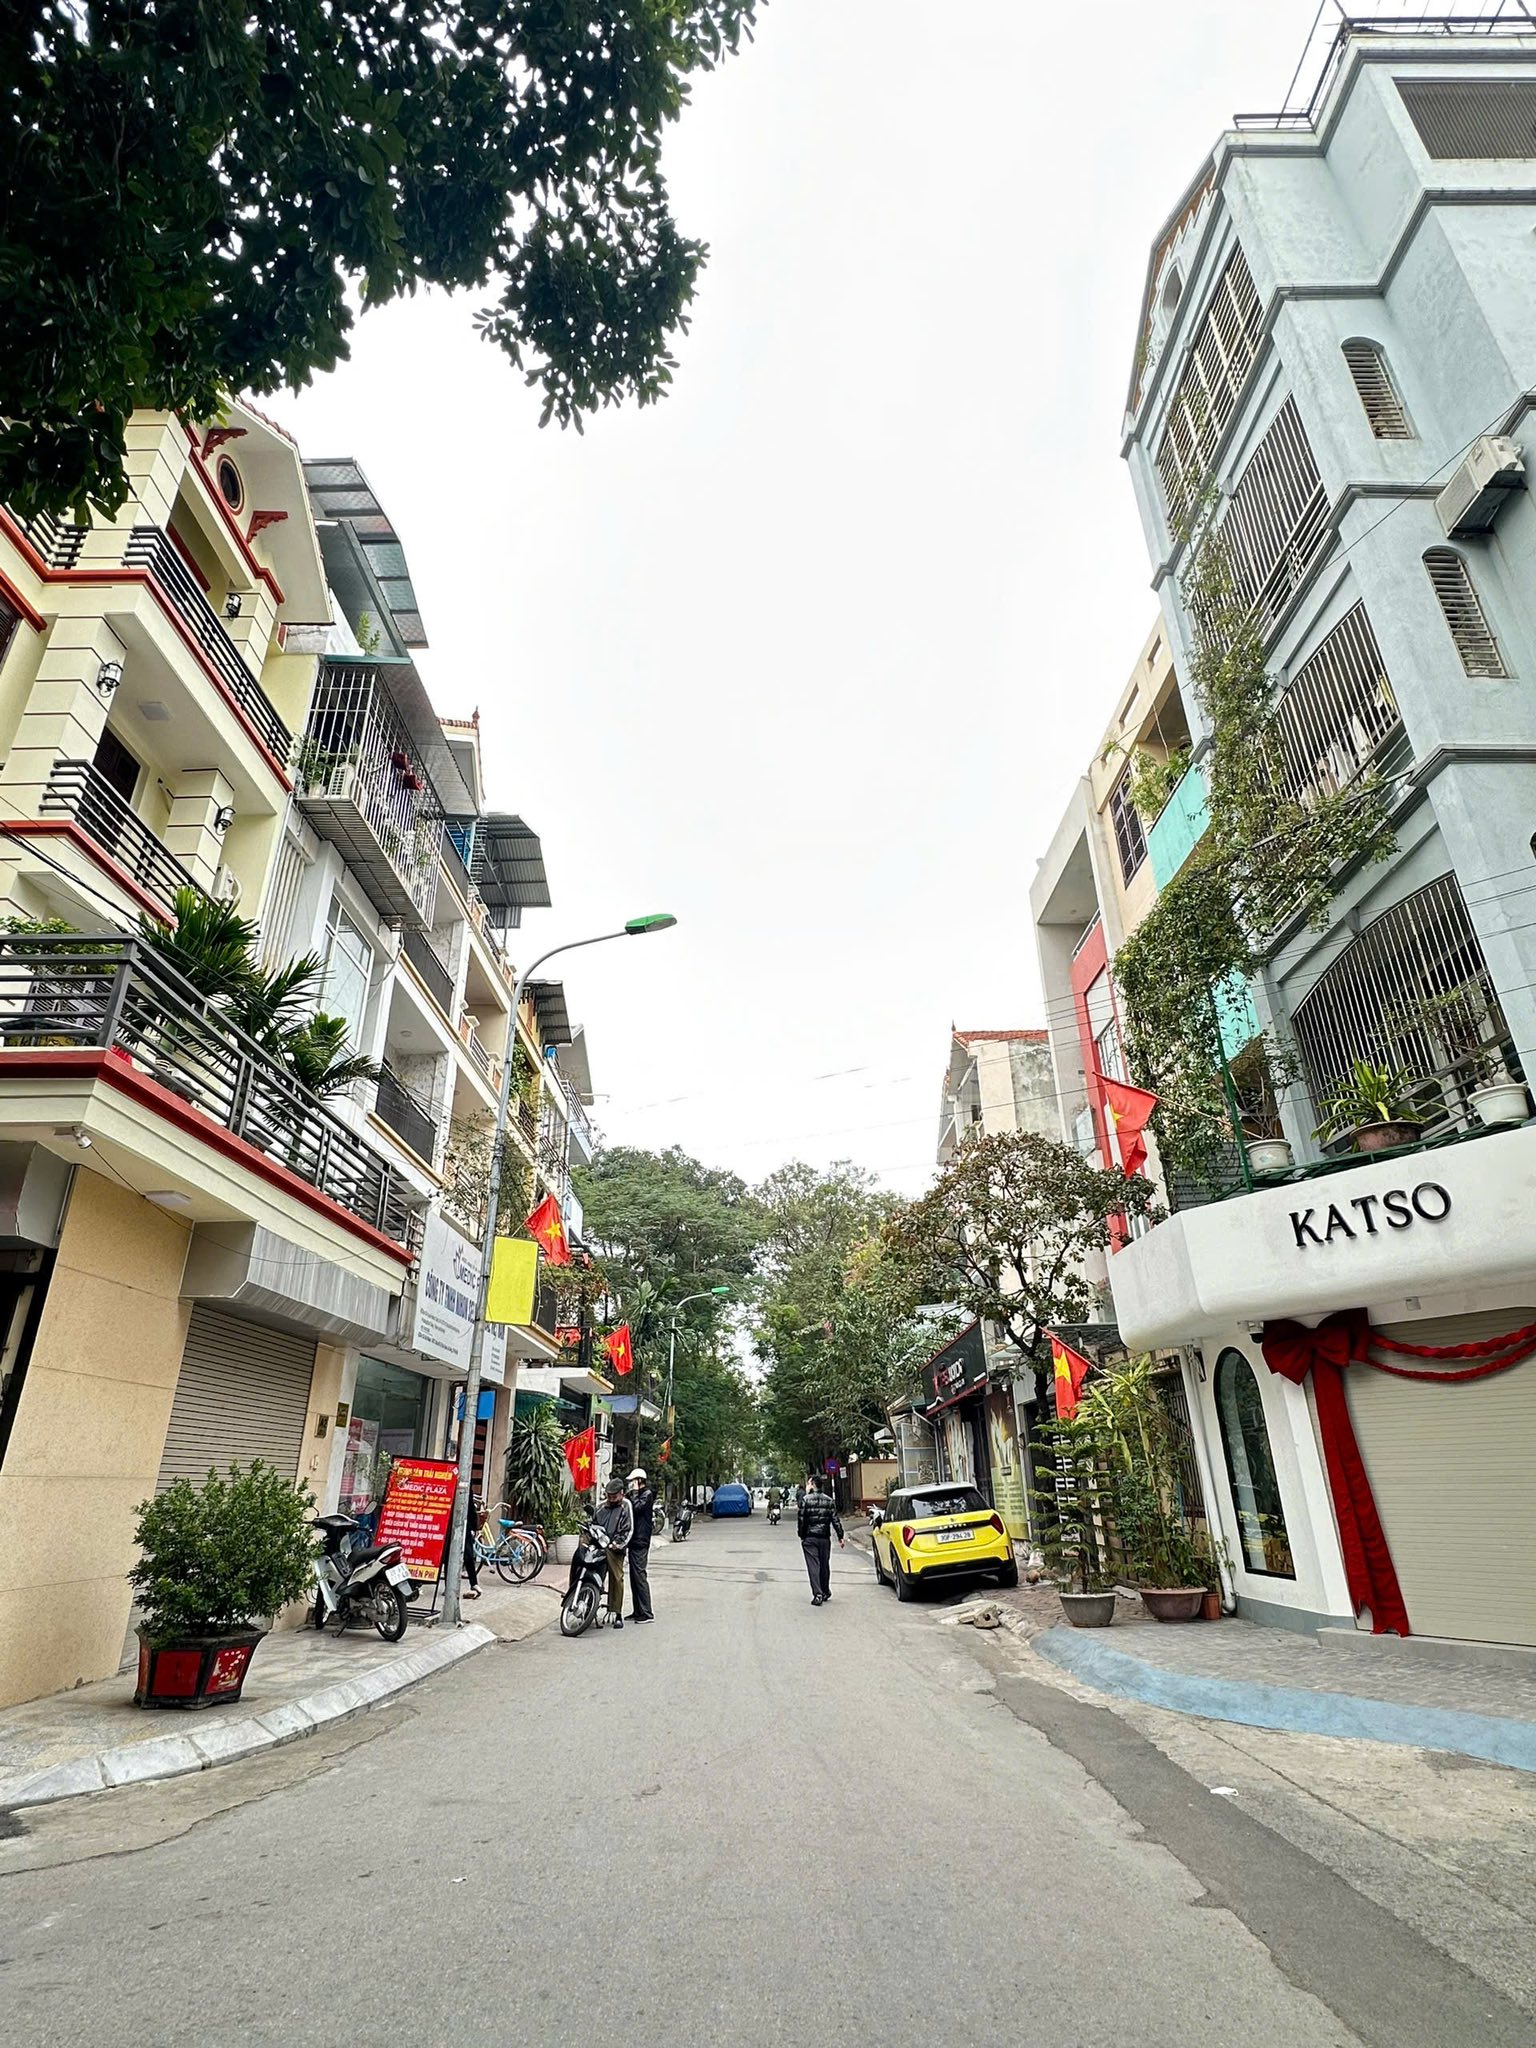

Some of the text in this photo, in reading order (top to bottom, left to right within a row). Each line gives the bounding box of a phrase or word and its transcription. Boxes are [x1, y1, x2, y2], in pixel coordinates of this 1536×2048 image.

[1288, 1182, 1452, 1248] KATSO
[460, 1264, 477, 1289] MEDIC
[404, 1483, 425, 1492] MEDIC
[425, 1486, 447, 1495] PLAZA
